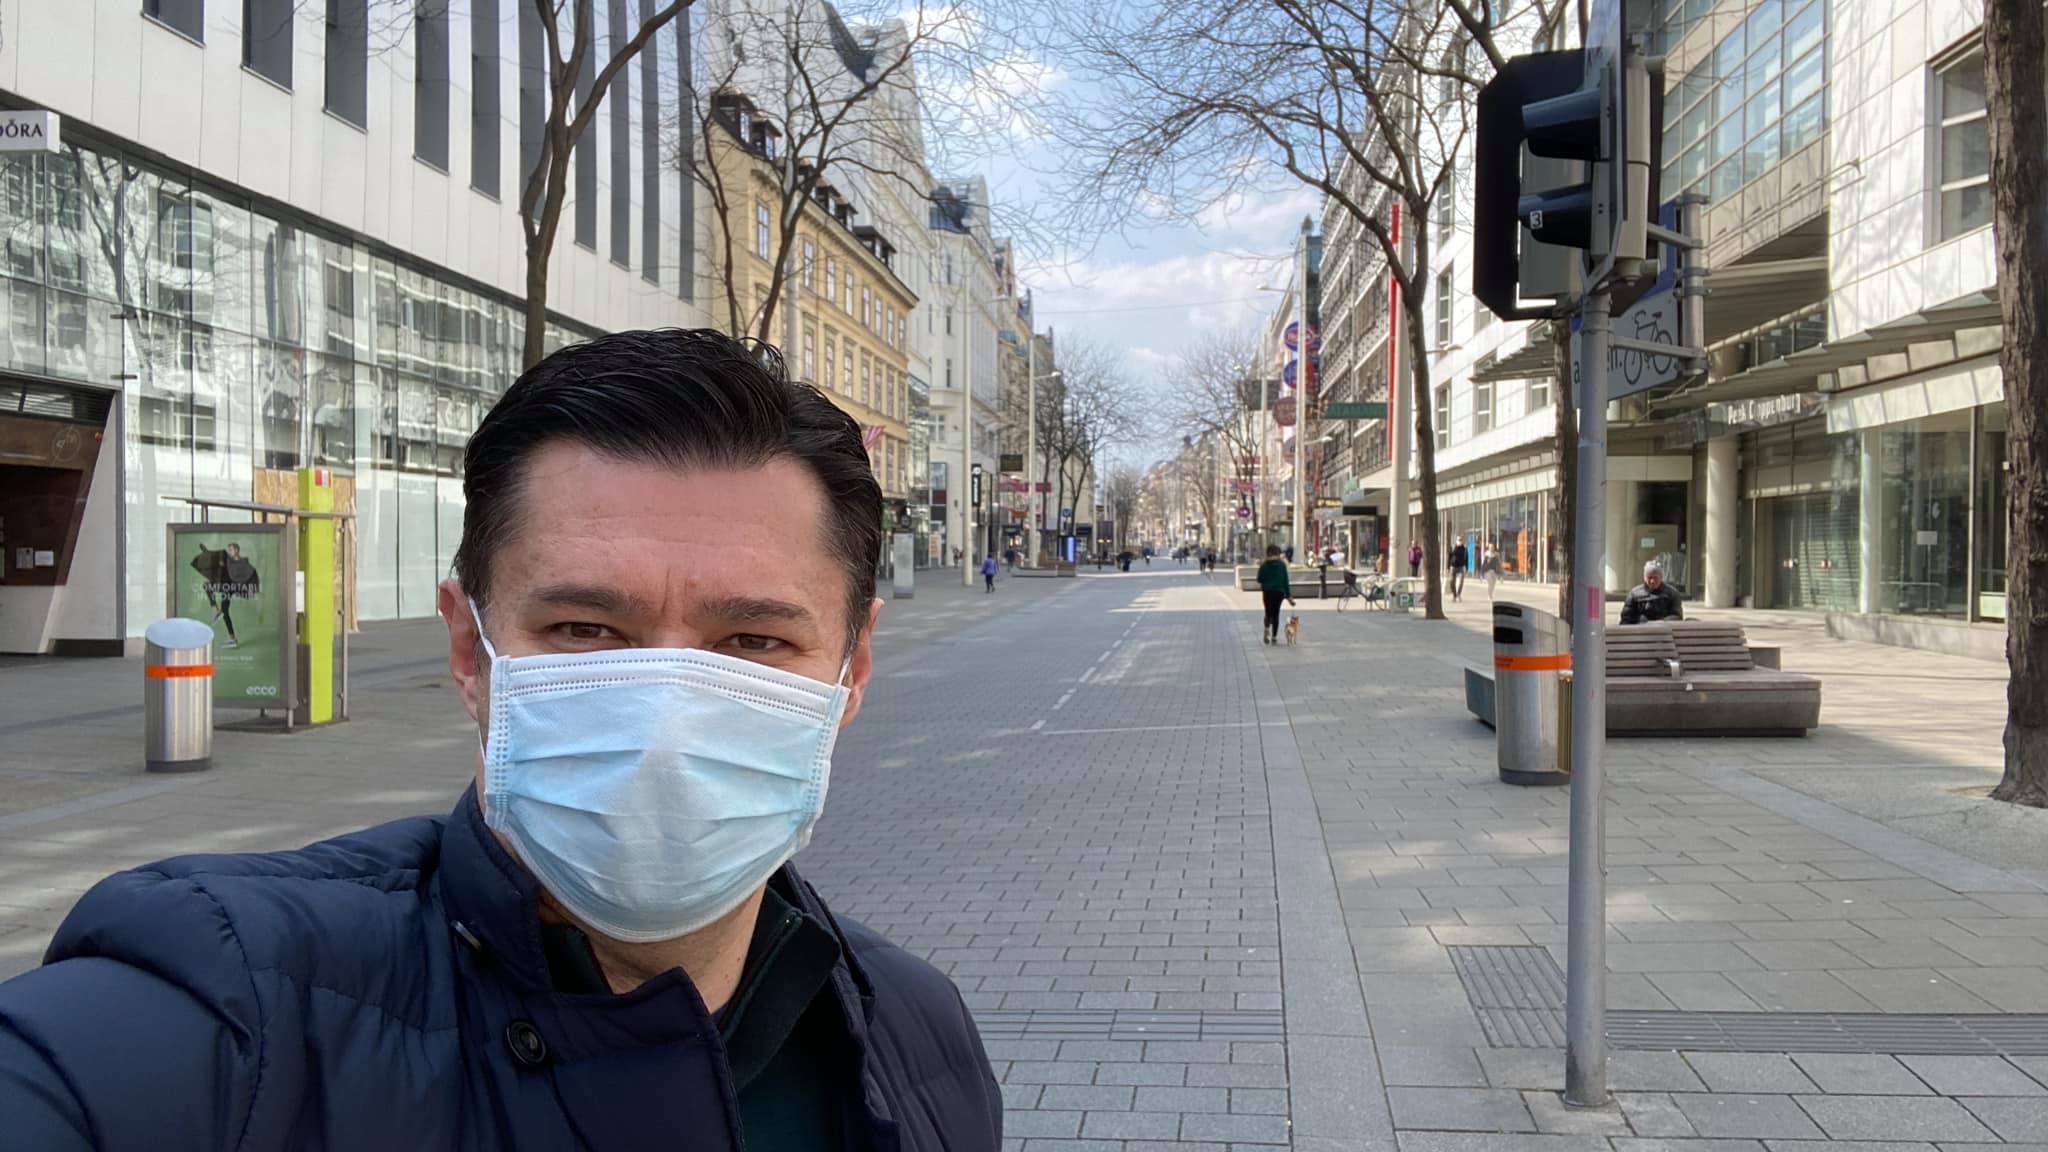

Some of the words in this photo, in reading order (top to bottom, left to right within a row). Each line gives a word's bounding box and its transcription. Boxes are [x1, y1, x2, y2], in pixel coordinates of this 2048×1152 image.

[1532, 212, 1540, 228] 3
[1749, 393, 1800, 420] Coppenburg
[246, 686, 276, 696] ecco
